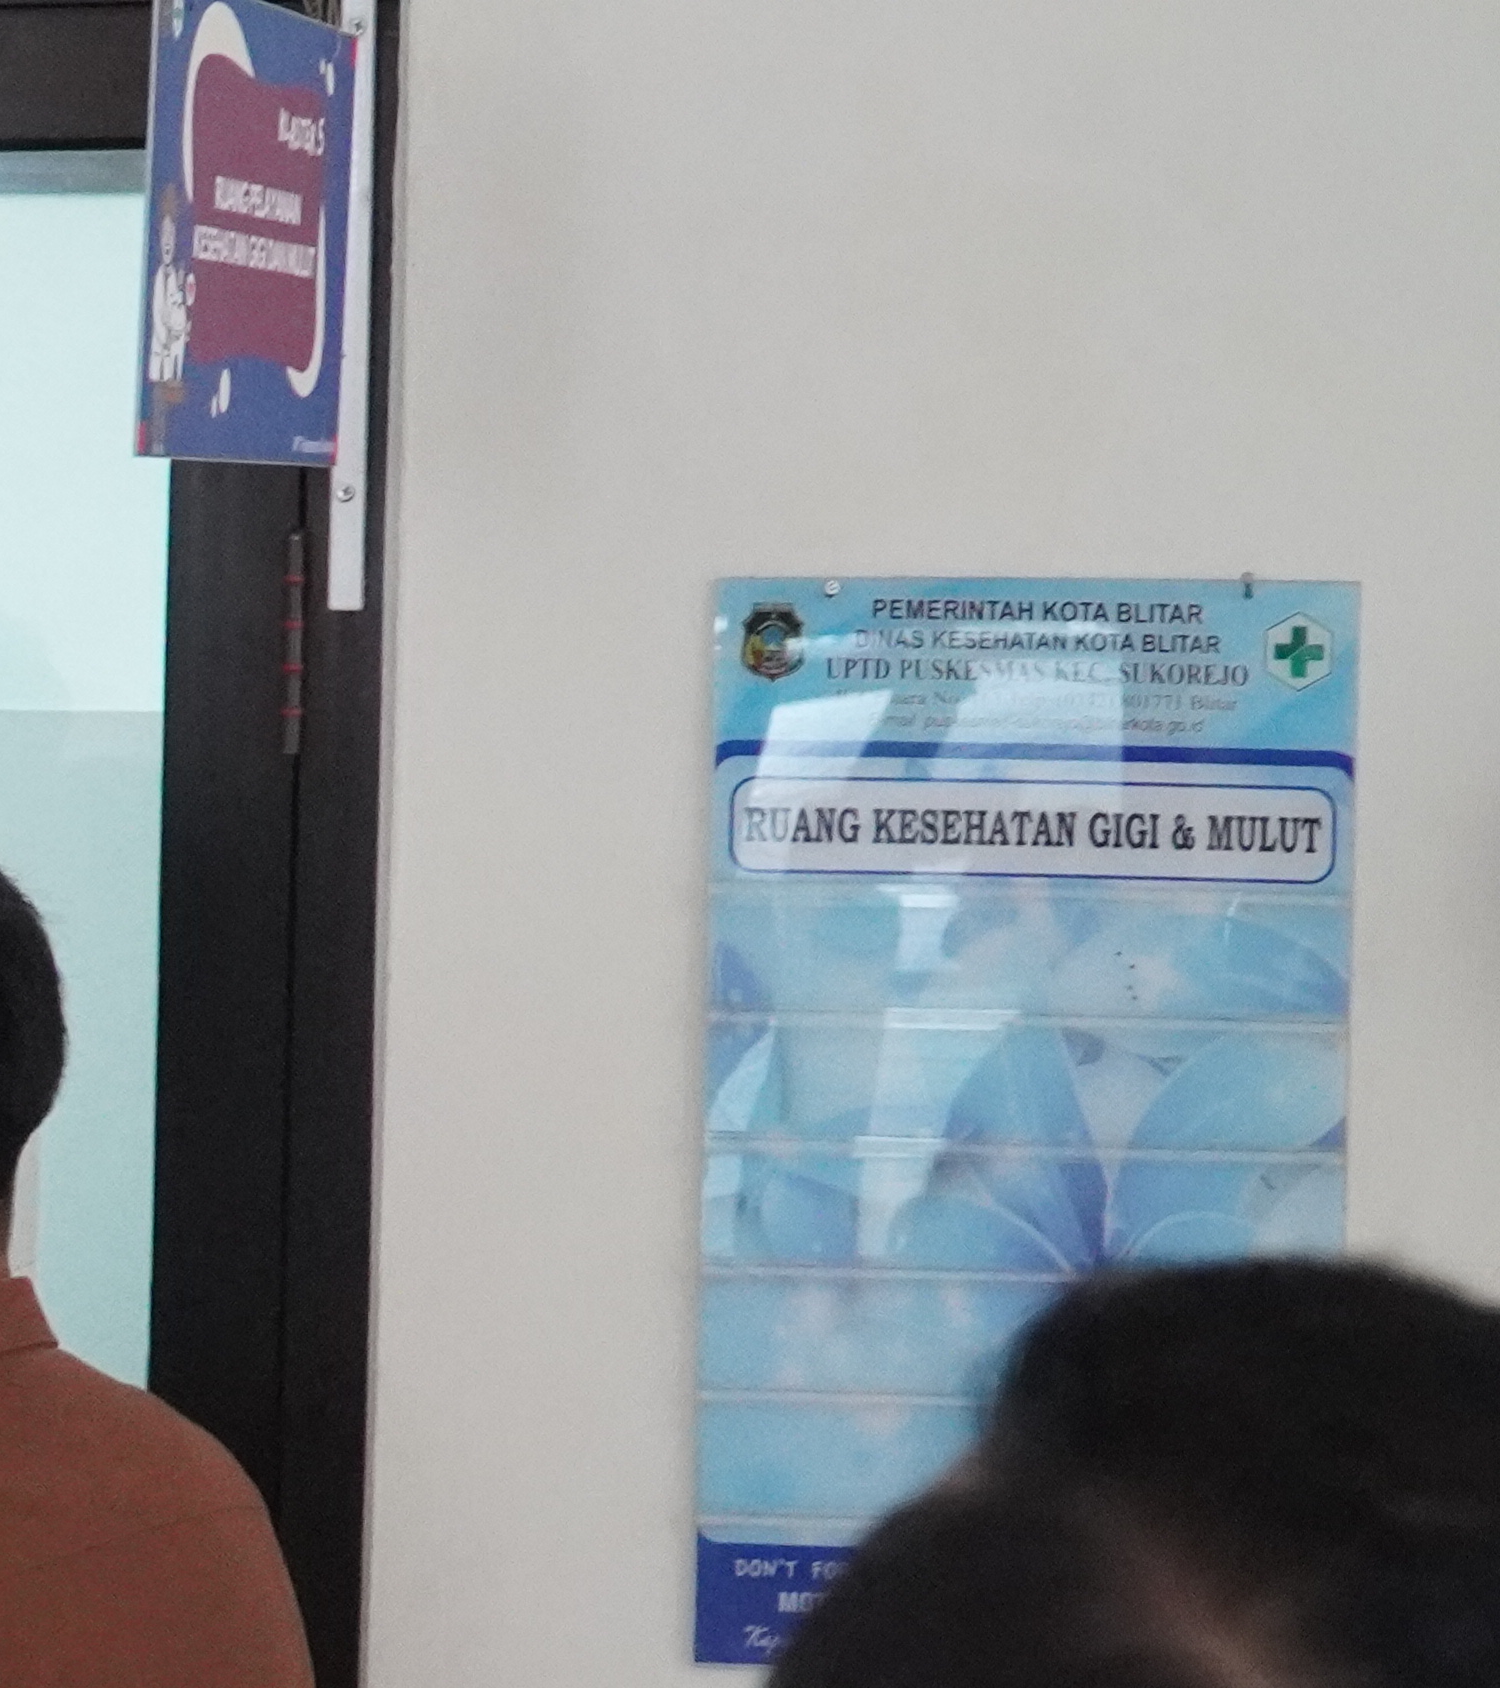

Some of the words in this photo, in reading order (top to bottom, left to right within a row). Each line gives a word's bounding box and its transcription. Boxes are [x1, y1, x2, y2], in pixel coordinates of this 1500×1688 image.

[872, 598, 1033, 622] PEMERINTAH
[1042, 601, 1109, 623] KOTA
[1117, 602, 1205, 626] BLITAR
[854, 629, 925, 649] DINAS
[932, 631, 1067, 652] KESEHATAN
[1074, 633, 1135, 652] KOTA
[1142, 634, 1223, 655] BLITAR
[826, 657, 891, 680] UPTD
[1119, 662, 1251, 687] SUKOREJO
[743, 806, 862, 844] RUANG
[872, 807, 1077, 847] KESEHATAN
[1088, 810, 1160, 850] GIGI
[1171, 813, 1195, 851] &
[1206, 814, 1323, 853] MULUT
[734, 1558, 798, 1579] DON'T
[811, 1560, 850, 1581] FO
